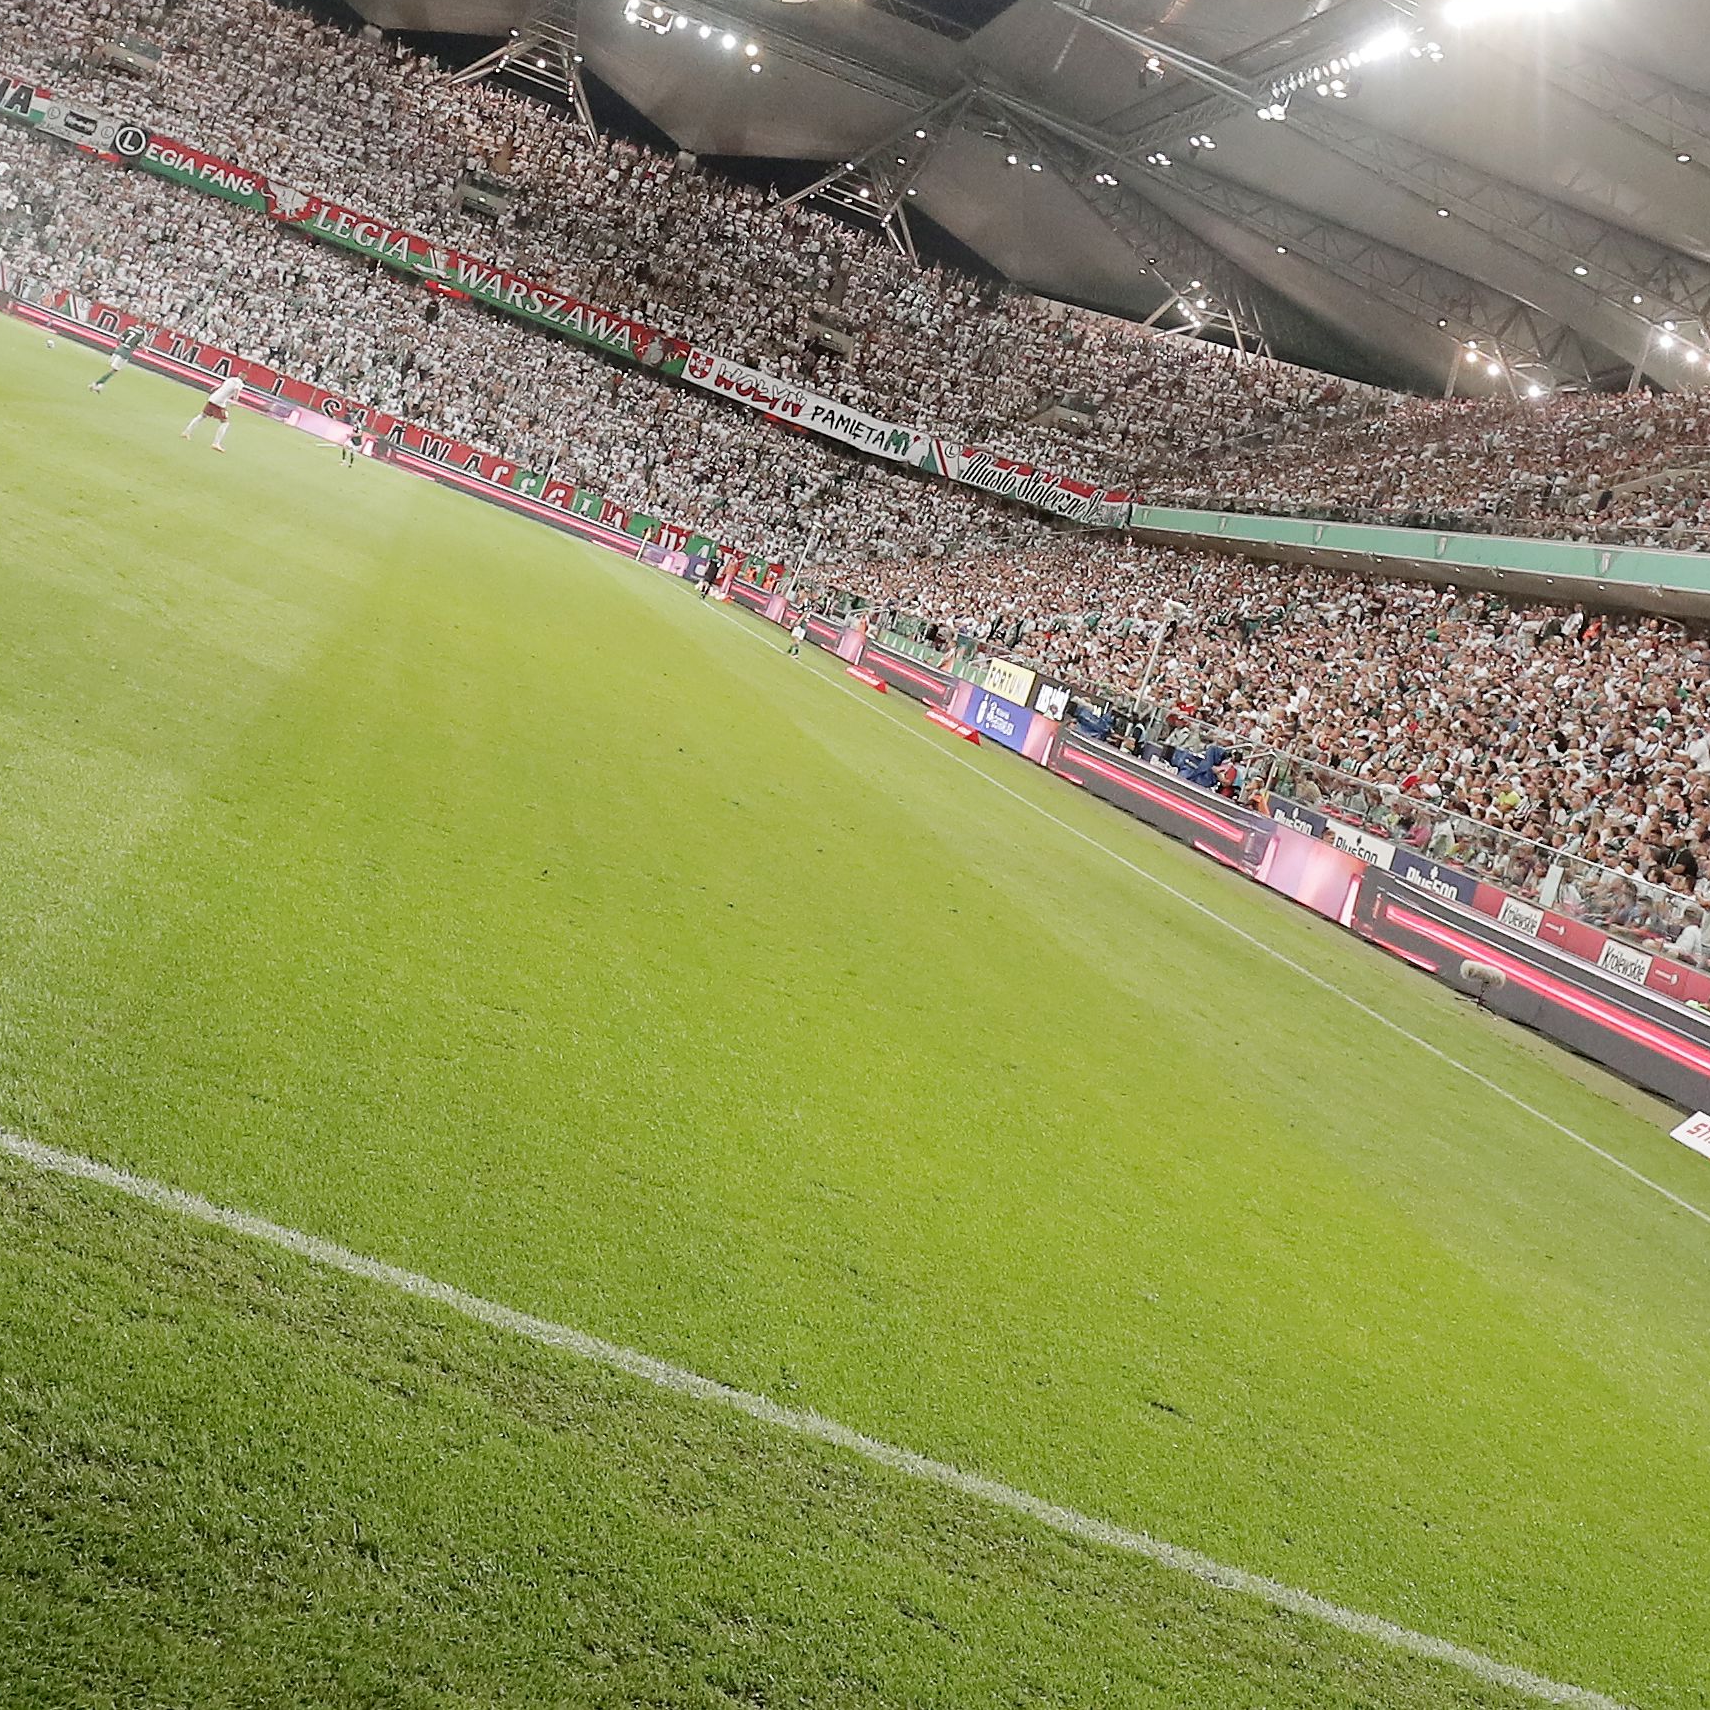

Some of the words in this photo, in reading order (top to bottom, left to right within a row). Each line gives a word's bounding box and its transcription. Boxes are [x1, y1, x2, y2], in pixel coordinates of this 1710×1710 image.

[198, 162, 258, 197] FANS
[311, 205, 410, 263] LEGIA
[456, 255, 636, 353] WARSZAWA
[810, 404, 921, 458] PAMIĘTAMY
[961, 452, 1019, 495] Miasto
